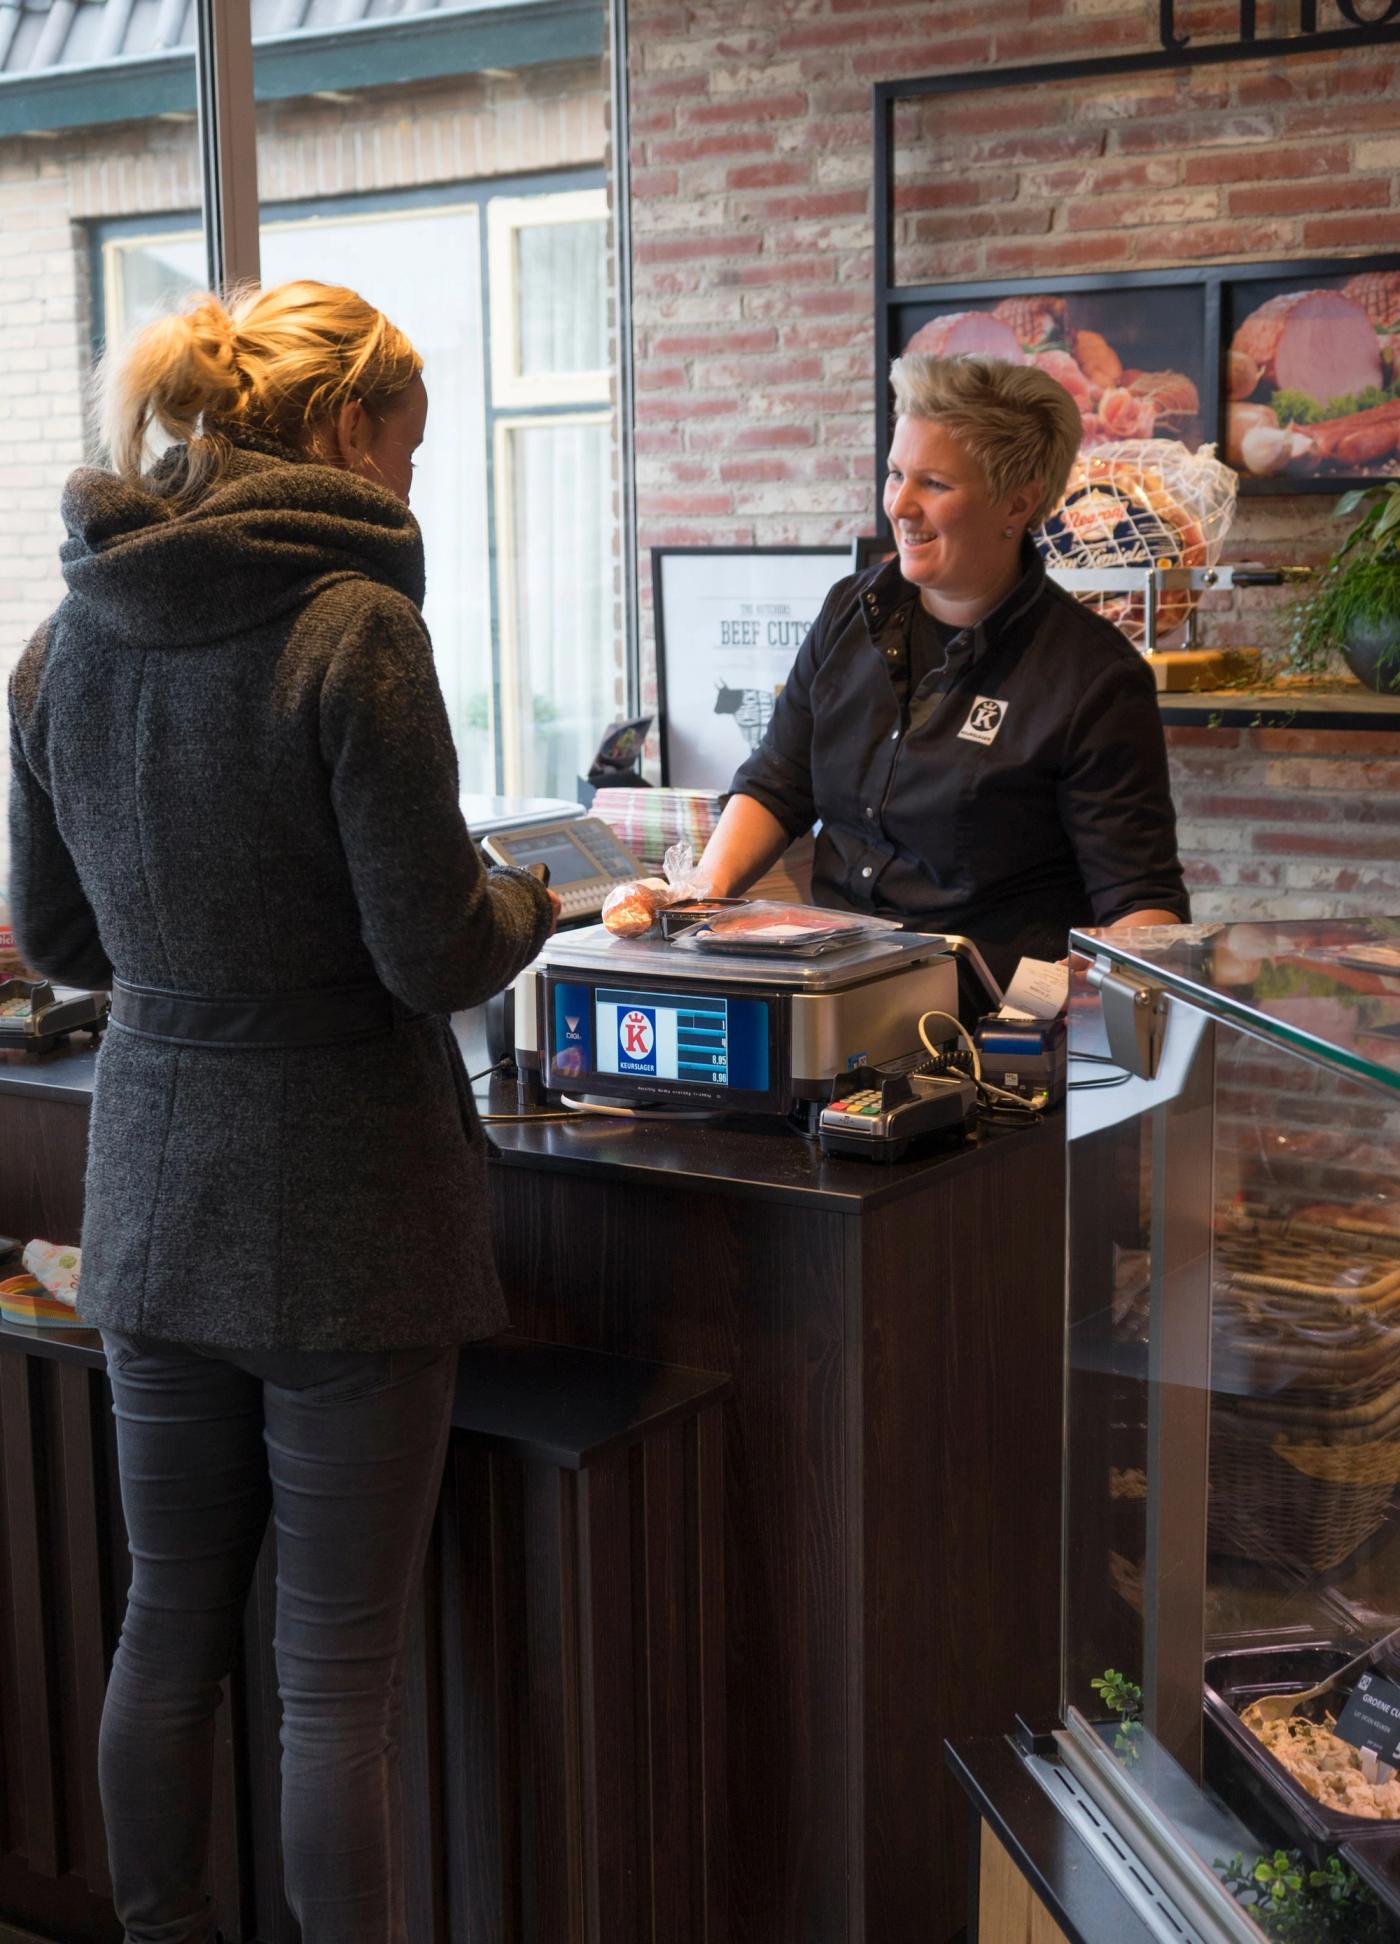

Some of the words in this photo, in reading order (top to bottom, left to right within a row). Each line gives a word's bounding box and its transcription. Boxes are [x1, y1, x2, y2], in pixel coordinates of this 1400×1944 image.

[721, 620, 760, 645] BEEF
[971, 707, 998, 729] K
[625, 1024, 649, 1053] K
[620, 1062, 655, 1072] KEURSLAGER
[1362, 1693, 1391, 1713] GROENE
